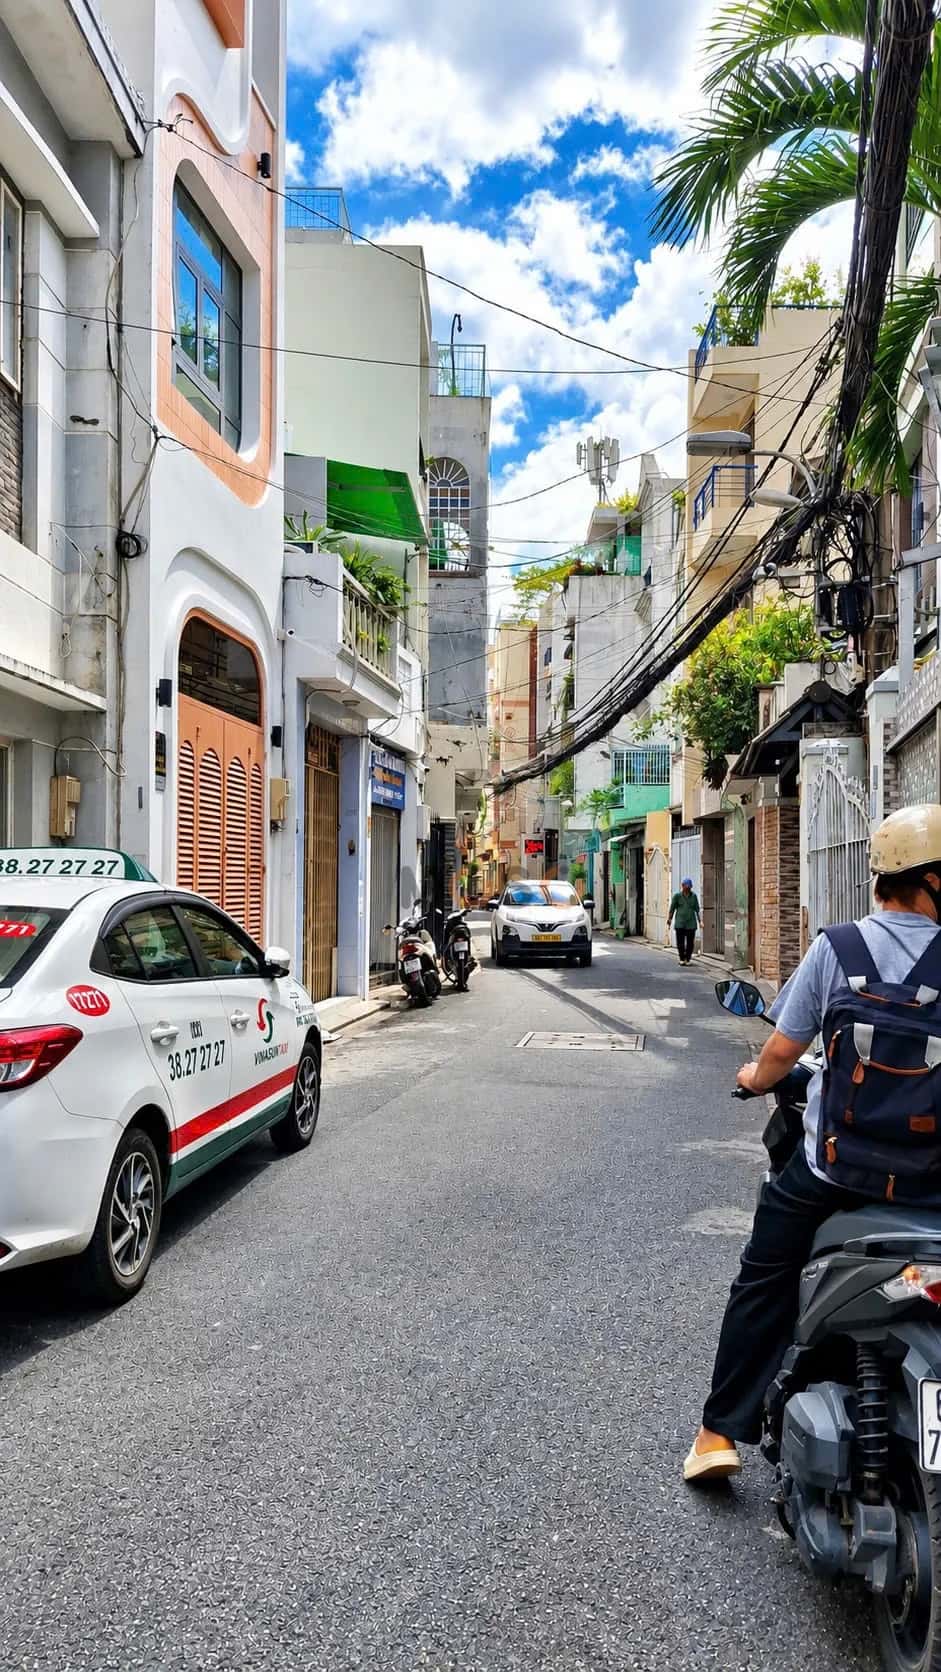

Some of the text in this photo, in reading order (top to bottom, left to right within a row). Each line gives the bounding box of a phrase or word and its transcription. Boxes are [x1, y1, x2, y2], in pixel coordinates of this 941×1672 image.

[59, 859, 87, 875] 27
[91, 860, 119, 876] 27
[69, 991, 108, 1010] 17271
[168, 1039, 225, 1081] 38.27 27 27
